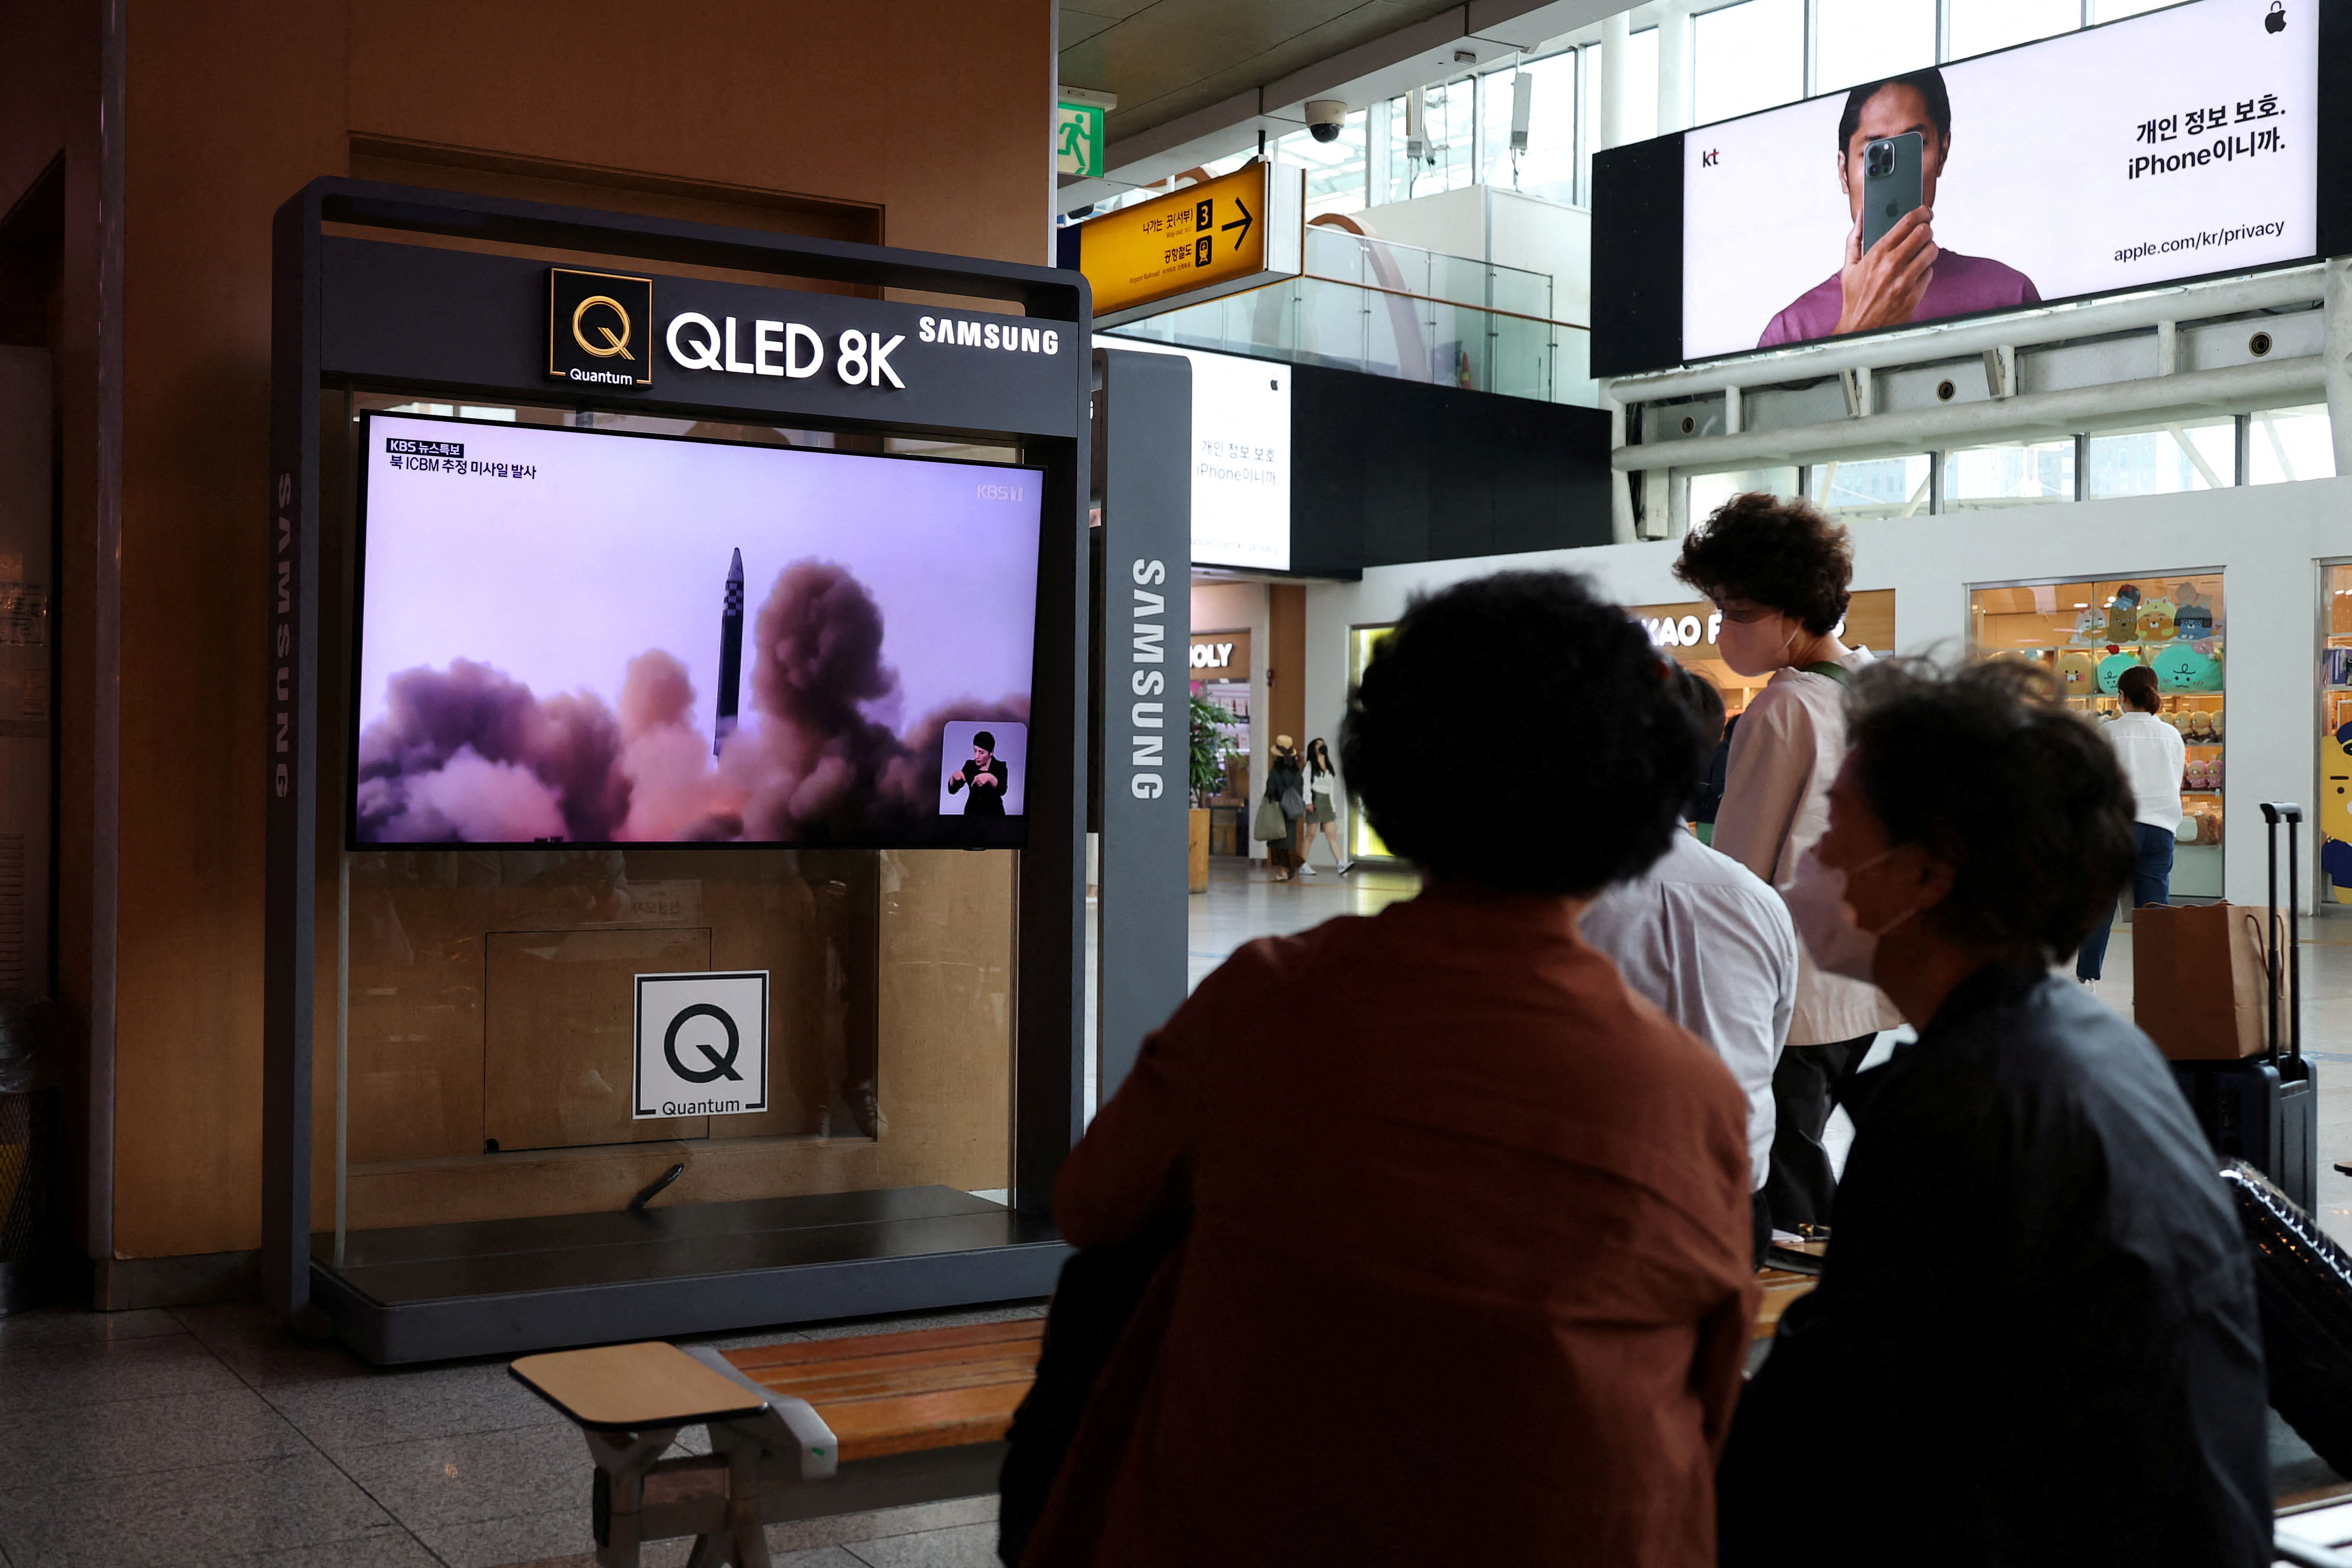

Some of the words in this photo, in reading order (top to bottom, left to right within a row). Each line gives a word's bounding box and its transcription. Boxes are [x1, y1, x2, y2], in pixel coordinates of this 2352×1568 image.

[2136, 115, 2177, 144] 개인
[2185, 105, 2228, 135] 정보
[2234, 93, 2285, 124] 보호.
[1703, 148, 1719, 168] kt
[2129, 127, 2285, 180] iPhone이니까.
[1143, 219, 1163, 234] 나가는
[1167, 208, 1193, 229] 곳(서부)
[1201, 205, 1209, 226] 3
[1165, 244, 1192, 264] 공항철도
[2114, 221, 2285, 262] apple.com/kr/privacy
[1130, 275, 1143, 283] Airport
[1144, 270, 1160, 279] Railroad
[572, 296, 635, 361] Q
[919, 316, 1058, 355] SAMSUNG
[666, 312, 824, 379] QLED
[837, 329, 906, 389] 8K
[570, 368, 633, 386] Quantum
[390, 440, 416, 452] KBS
[418, 442, 460, 456] 뉴스특보
[1202, 440, 1223, 457] 개인
[1229, 443, 1249, 459] 정보
[1254, 447, 1279, 463] 보호.
[390, 455, 403, 470] 북
[406, 457, 439, 472] ICBM
[442, 459, 467, 475] 추정
[471, 461, 508, 477] 미사일
[511, 464, 536, 479] 발사
[1197, 463, 1279, 486] iPhone이니까.
[276, 472, 291, 798] SAMSUNG
[1189, 643, 1233, 668] OLY
[1131, 558, 1166, 799] SAMSUNG
[664, 1003, 743, 1083] Q
[662, 1098, 740, 1116] Quantum
